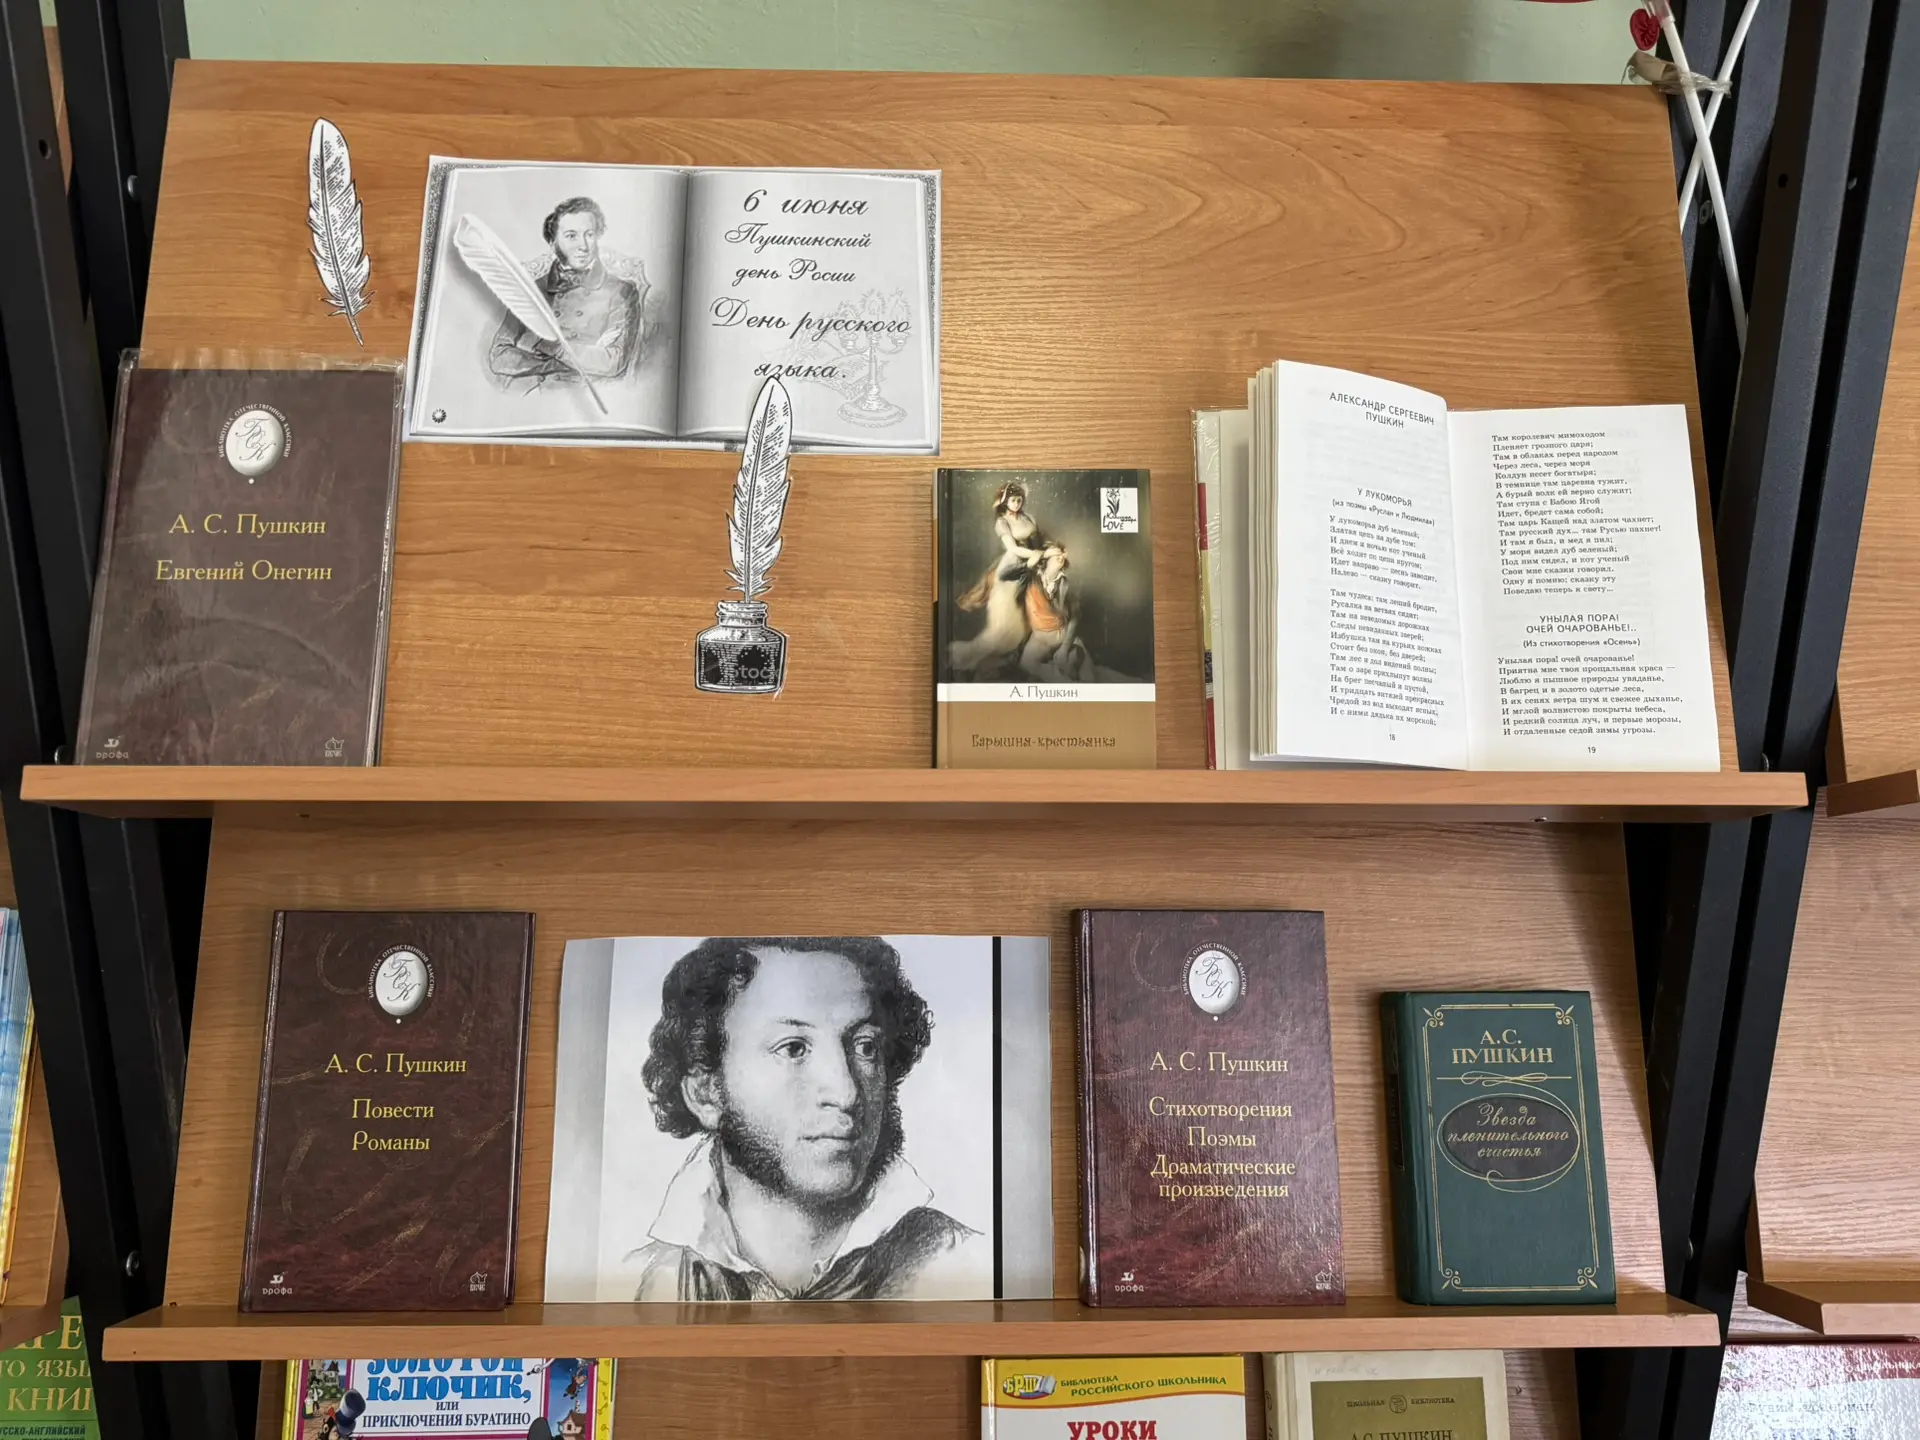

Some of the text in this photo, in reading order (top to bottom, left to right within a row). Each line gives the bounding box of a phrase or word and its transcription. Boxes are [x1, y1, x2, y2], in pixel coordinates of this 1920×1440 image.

[743, 189, 868, 215] 6 июня
[725, 223, 872, 253] Пушкинский
[732, 258, 856, 286] день Росии
[710, 297, 911, 341] День русского
[1330, 392, 1435, 426] АЛЕКСАНДР СЕРГЕЕВИЧ
[1365, 411, 1404, 429] ПУШКИН
[1365, 490, 1413, 506] ЛУКОМОРЬЯ
[169, 513, 327, 538] А. С. Пушкин
[155, 560, 332, 580] Евгений Онегин
[1527, 624, 1636, 633] ОЧЕЙ ОЧАРОВАНЬЕ!..
[1540, 614, 1619, 623] УНЫЛАЯ ПОРА!
[1524, 640, 1537, 648] (Из
[1603, 638, 1640, 646] «Осень»)
[1009, 685, 1078, 699] А. Пушкин
[972, 733, 1116, 749] Барышня-крестьянка
[1390, 733, 1396, 741] 18
[324, 1053, 467, 1077] А. С. Пушкин
[1150, 1051, 1288, 1075] А. С. Пушкин
[1452, 1047, 1553, 1064] ПУШКИН
[352, 1098, 435, 1119] Повести
[1149, 1096, 1293, 1121] Стихотворения
[1477, 1103, 1537, 1126] Звезда
[352, 1130, 430, 1151] Романы
[1188, 1126, 1256, 1146] Поэмы
[1447, 1131, 1569, 1142] пленительного
[1477, 1146, 1542, 1158] счастья
[1150, 1154, 1296, 1178] Драматические
[1159, 1184, 1289, 1201] произведения
[36, 1360, 91, 1377] ЯЗЫ
[366, 1374, 532, 1403] КЛЮЧИК,
[1061, 1375, 1118, 1387] БИБЛИОТЕКА
[1070, 1376, 1227, 1397] РОССИЙСКОГО ШКОЛЬНИКА
[436, 1401, 459, 1411] ИЛИ
[362, 1413, 531, 1428] ПРИКЛЮЧЕНИЯ БУРАТИНО
[1067, 1420, 1157, 1440] УРОКИ
